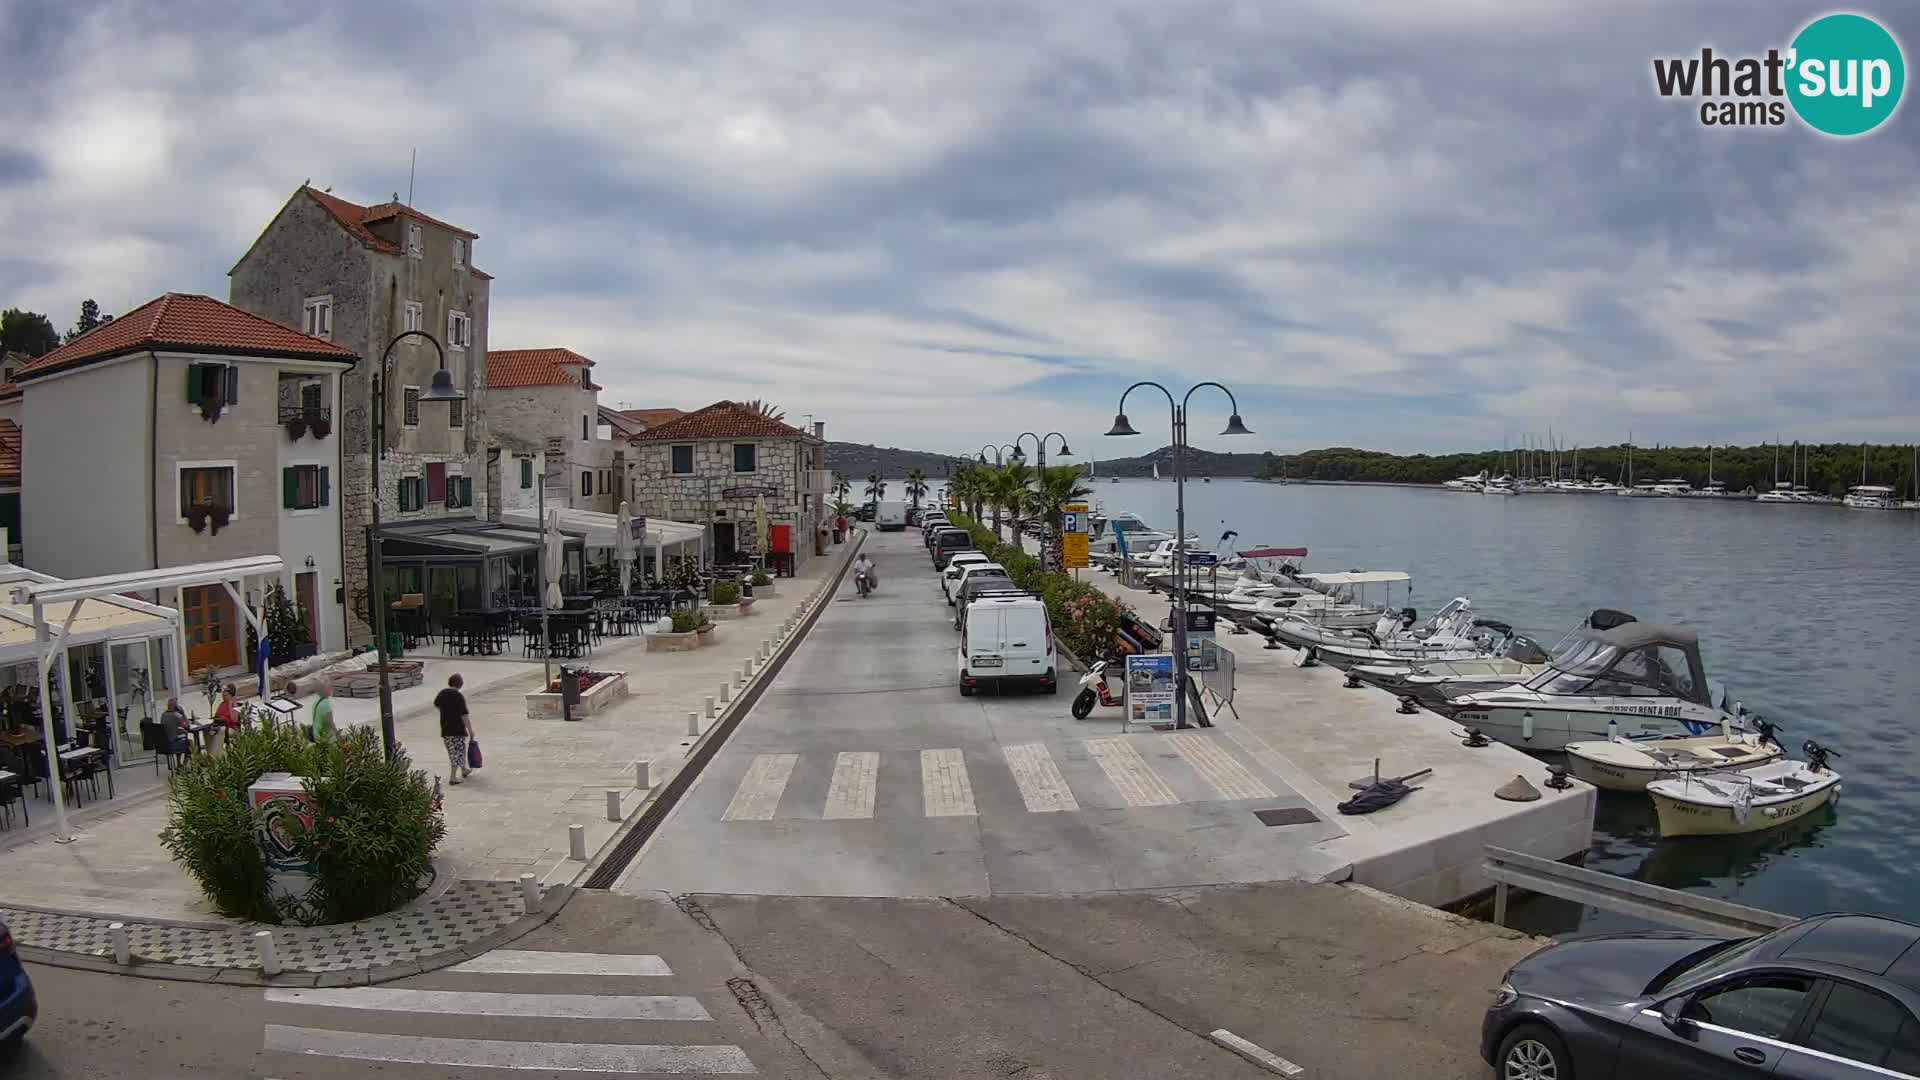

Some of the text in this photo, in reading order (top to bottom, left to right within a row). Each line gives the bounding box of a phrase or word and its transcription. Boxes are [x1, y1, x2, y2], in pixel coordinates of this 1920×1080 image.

[1065, 514, 1076, 531] P
[1638, 706, 1657, 714] RENT
[1658, 706, 1663, 715] A
[1664, 706, 1682, 717] BOAT
